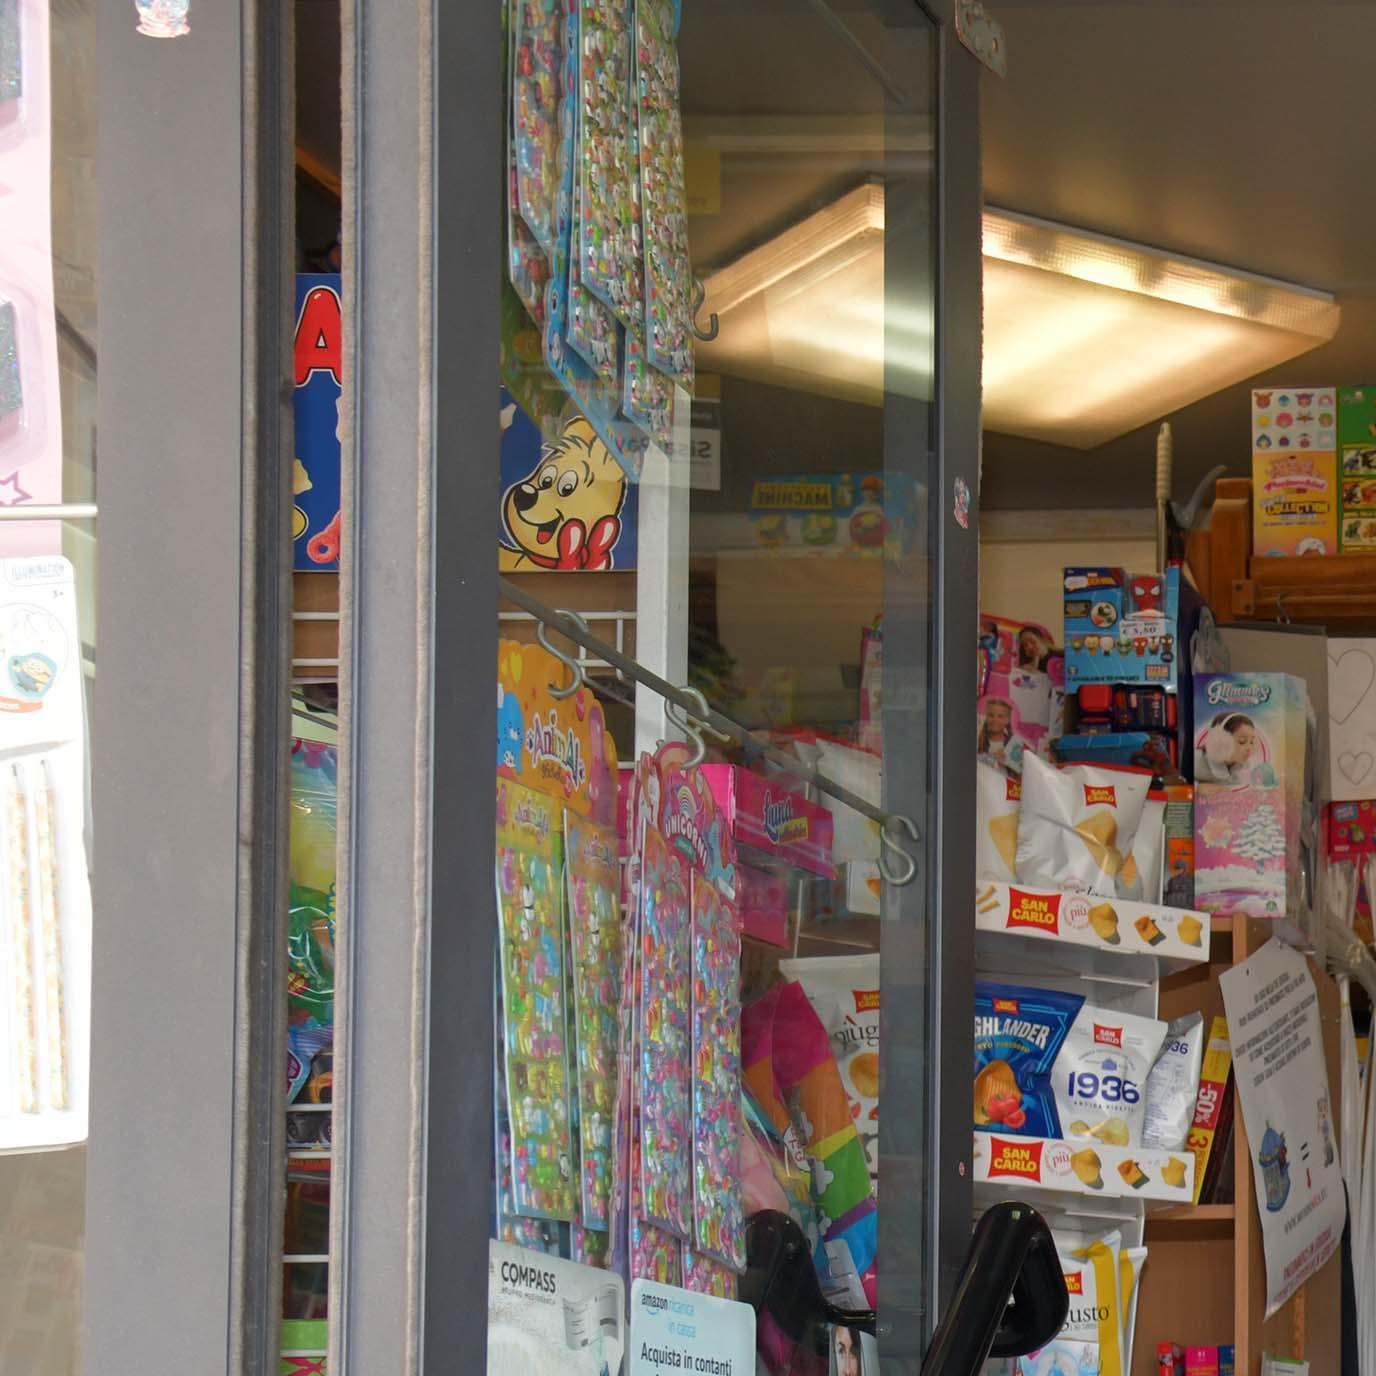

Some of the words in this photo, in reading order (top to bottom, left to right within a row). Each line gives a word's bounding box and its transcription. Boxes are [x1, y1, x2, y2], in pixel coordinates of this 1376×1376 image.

[1020, 898, 1048, 912] SAN
[1011, 908, 1055, 925] CARLO
[1067, 1071, 1141, 1105] 1936
[1003, 1147, 1031, 1160] SAN
[993, 1157, 1038, 1172] CARLO
[501, 1261, 556, 1294] COMPASS
[641, 1293, 668, 1312] amazon
[641, 1342, 682, 1372] Acquista
[683, 1349, 694, 1370] in
[695, 1352, 732, 1376] contanti
